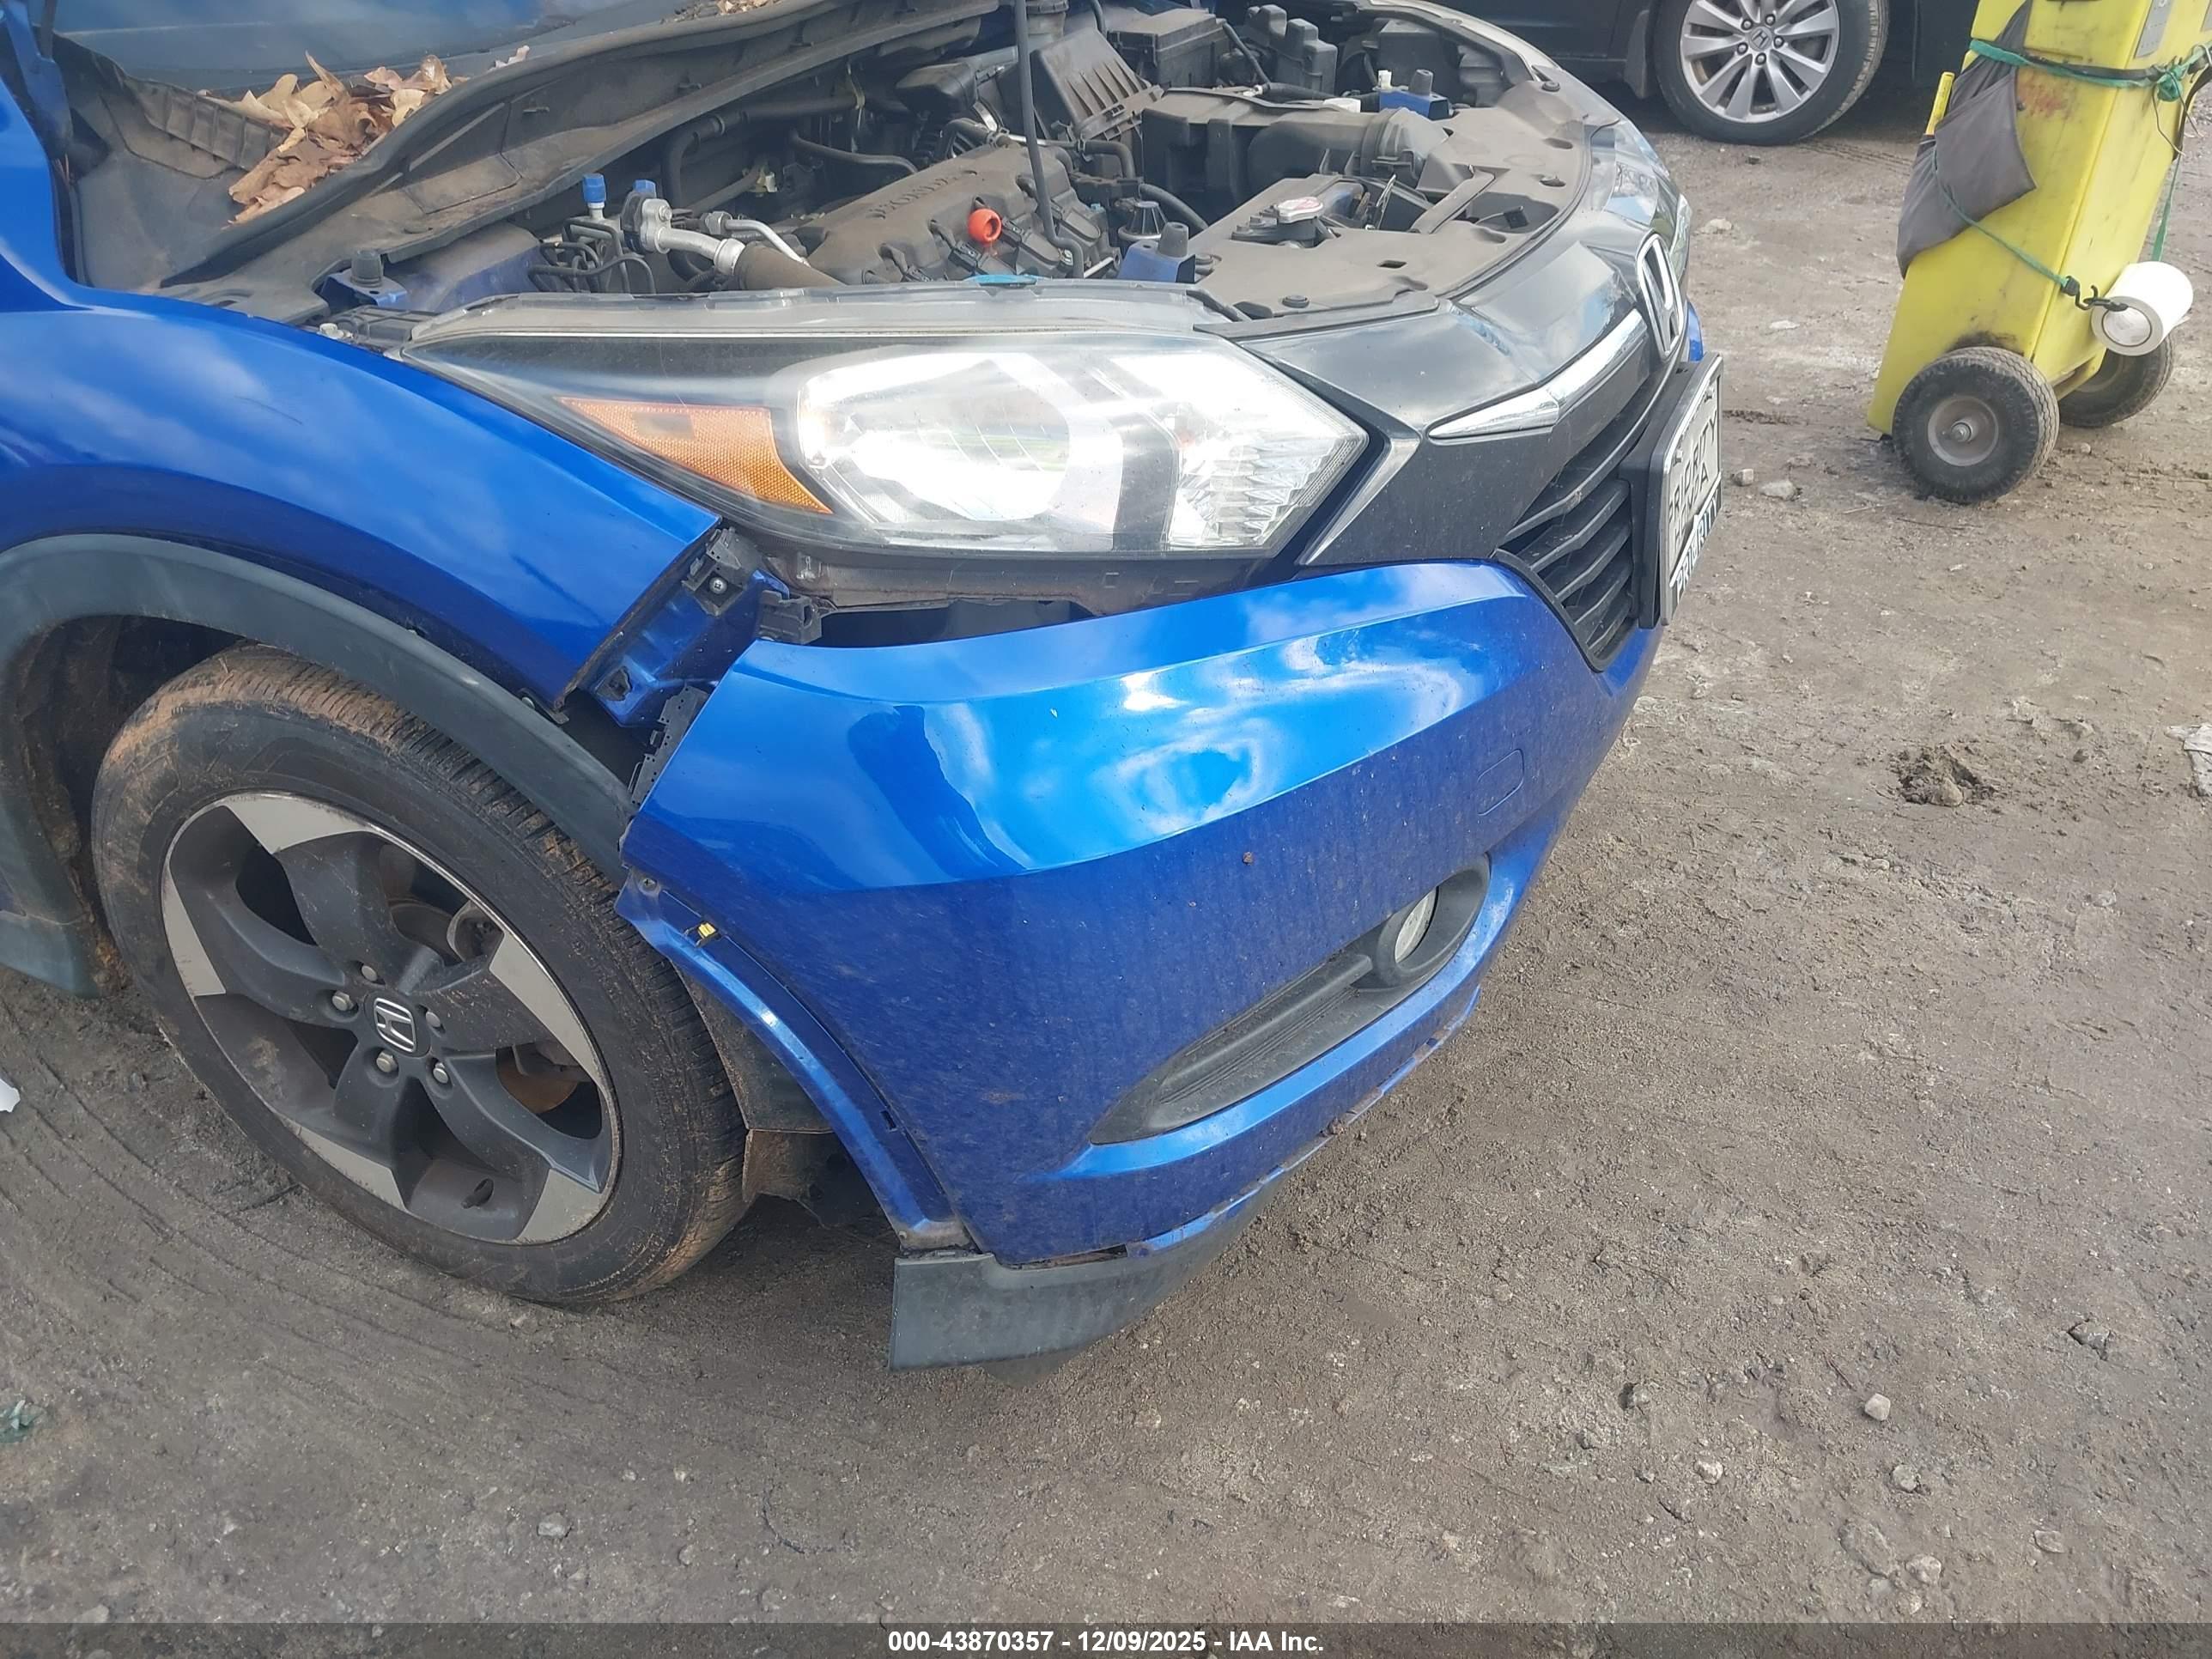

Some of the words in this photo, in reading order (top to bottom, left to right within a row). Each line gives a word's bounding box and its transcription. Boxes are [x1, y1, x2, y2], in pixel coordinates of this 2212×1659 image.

[1669, 410, 1717, 525] PRIORITY
[1675, 462, 1709, 556] HONDA
[1676, 487, 1717, 605] PRIORITY
